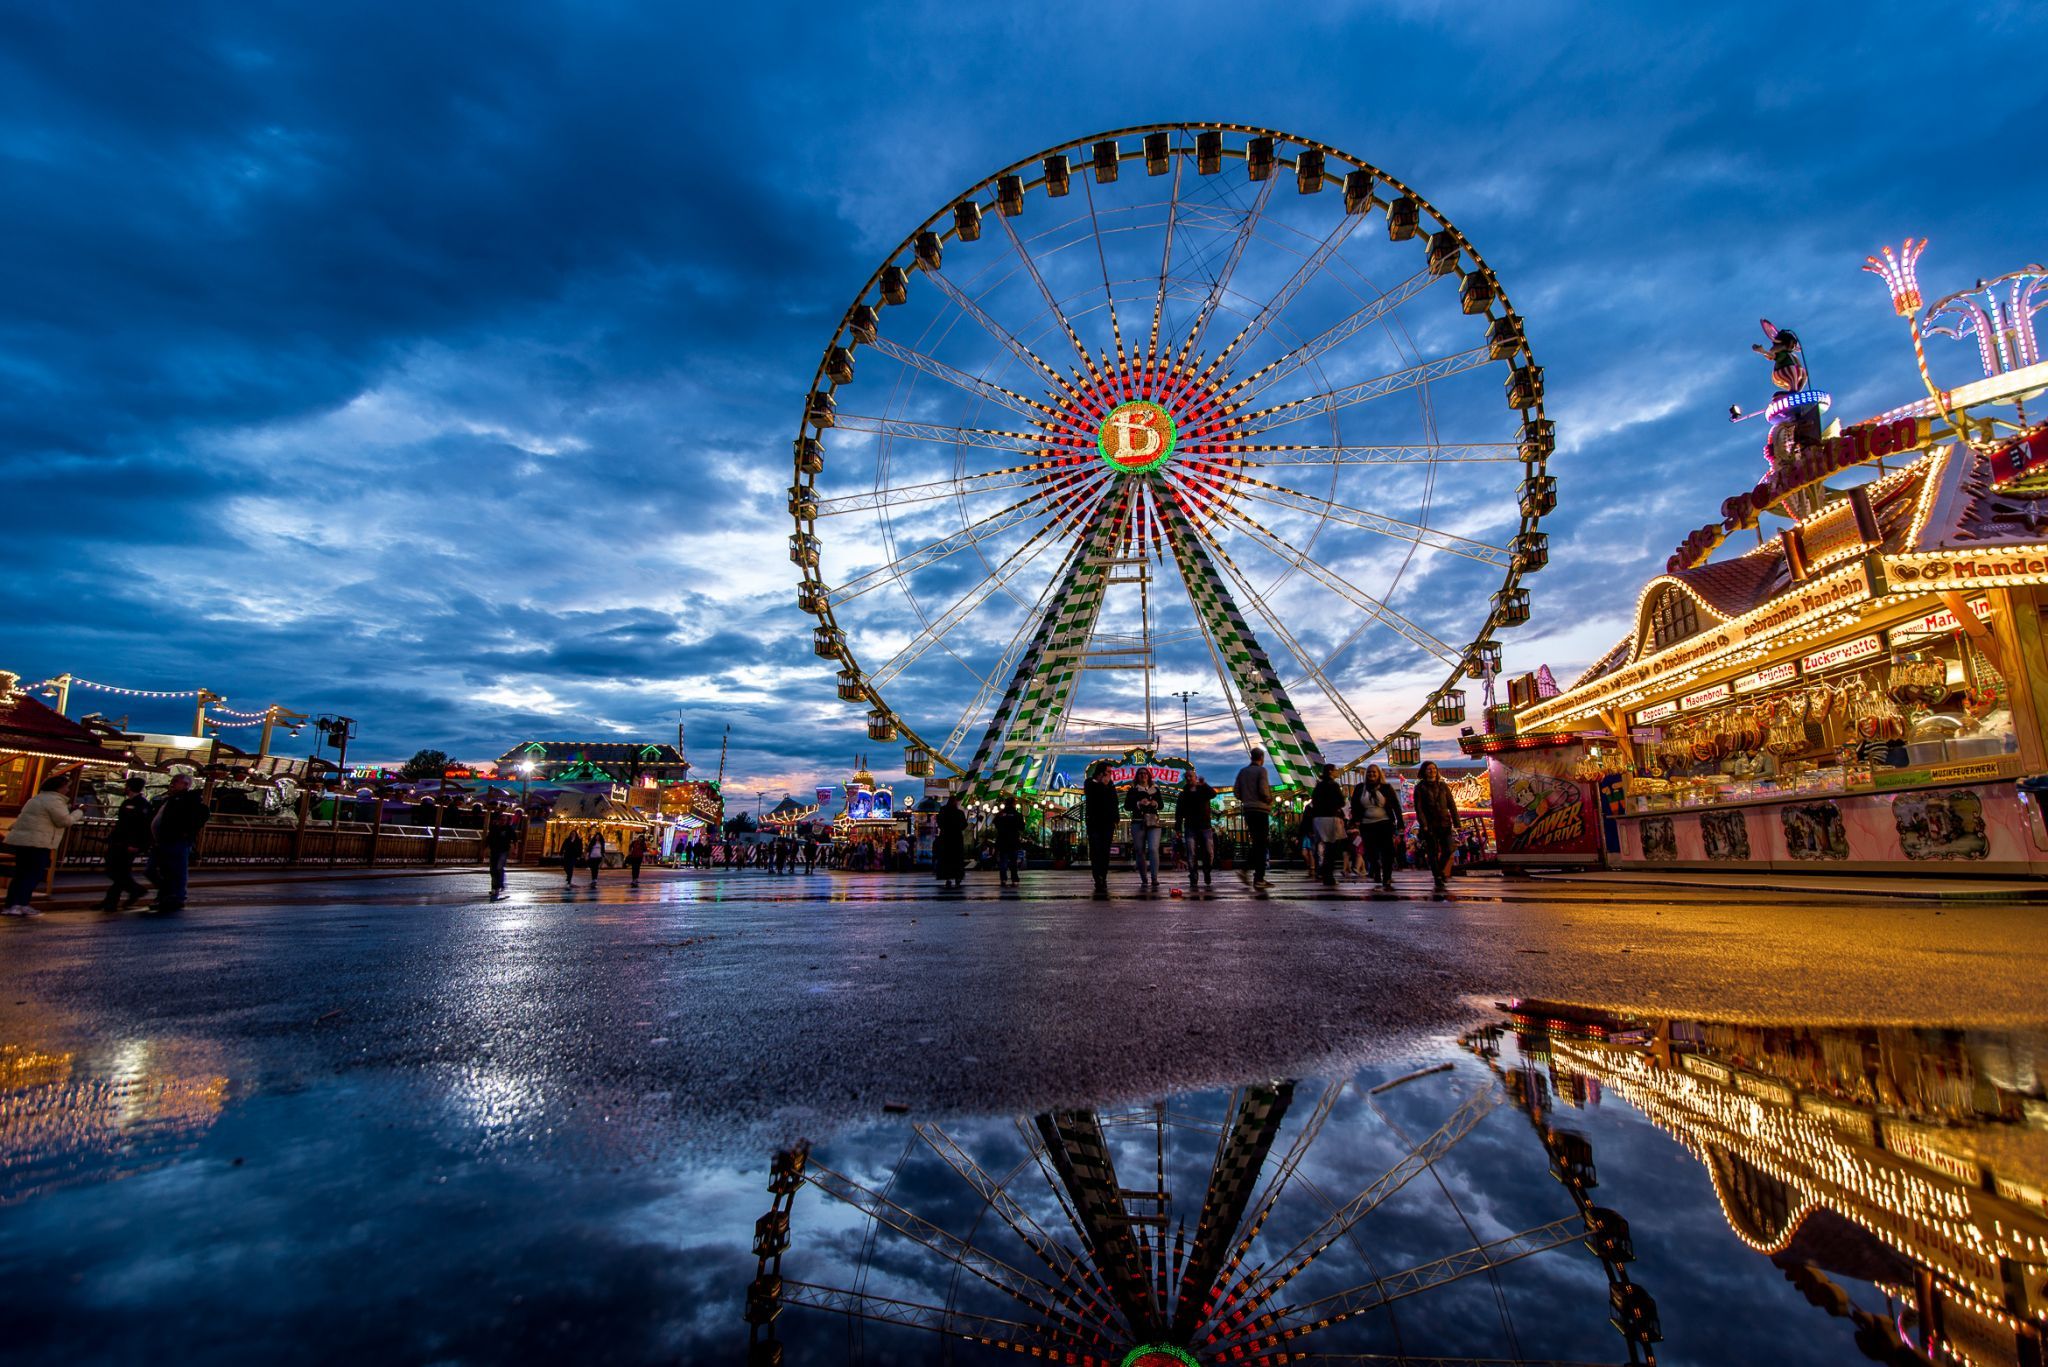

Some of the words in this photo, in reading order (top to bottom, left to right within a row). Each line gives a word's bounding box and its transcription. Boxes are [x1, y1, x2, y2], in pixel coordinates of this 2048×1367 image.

[1109, 409, 1161, 459] B
[1743, 604, 1800, 639] gebrannte
[1801, 577, 1863, 612] Mandeln
[1925, 600, 1990, 633] Manln
[1803, 637, 1878, 671] Zuckerwatte
[1758, 664, 1793, 682] Früchte
[1642, 706, 1669, 721] Popcorn
[1931, 762, 1998, 778] MUSIKFEUERWERK
[1527, 801, 1584, 847] POWER
[1544, 820, 1583, 846] DRIVE
